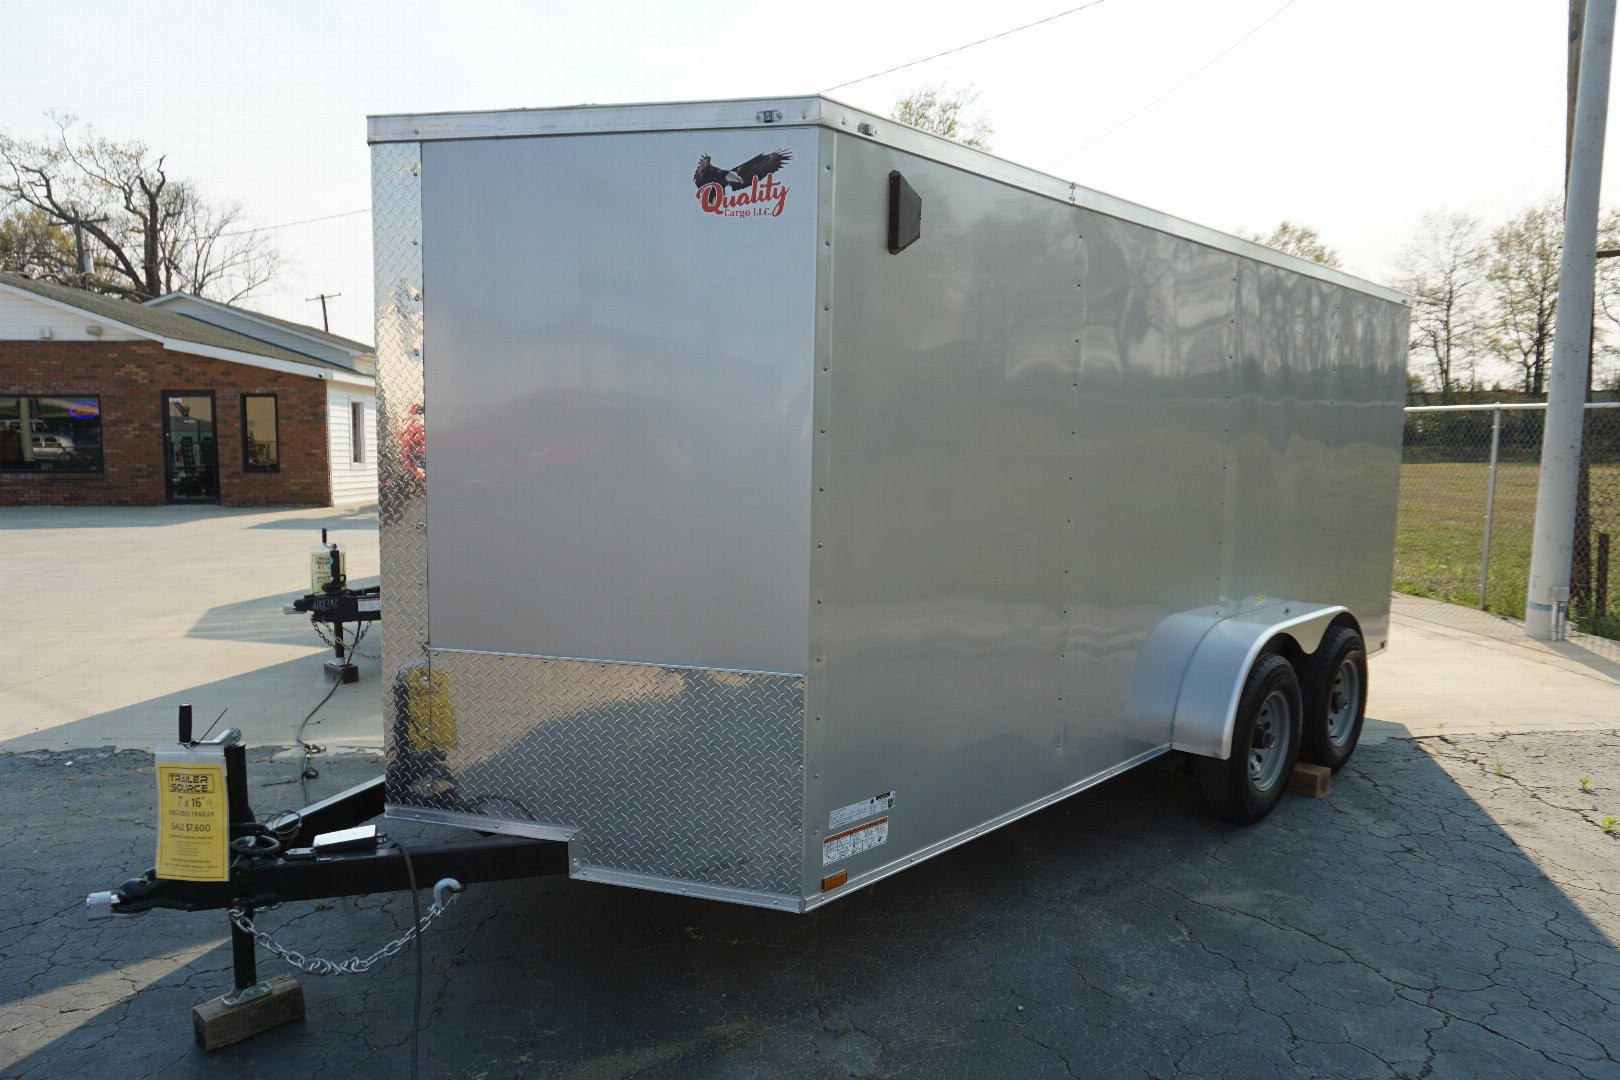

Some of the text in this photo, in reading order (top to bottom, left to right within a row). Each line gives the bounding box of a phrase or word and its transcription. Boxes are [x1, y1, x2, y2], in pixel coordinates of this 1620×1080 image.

[695, 172, 790, 217] Quality
[724, 209, 750, 218] Cargo
[170, 775, 208, 783] TRAILER
[171, 784, 208, 792] SOURCE
[191, 810, 215, 818] TRAILER
[171, 822, 211, 832] SALE $7,600
